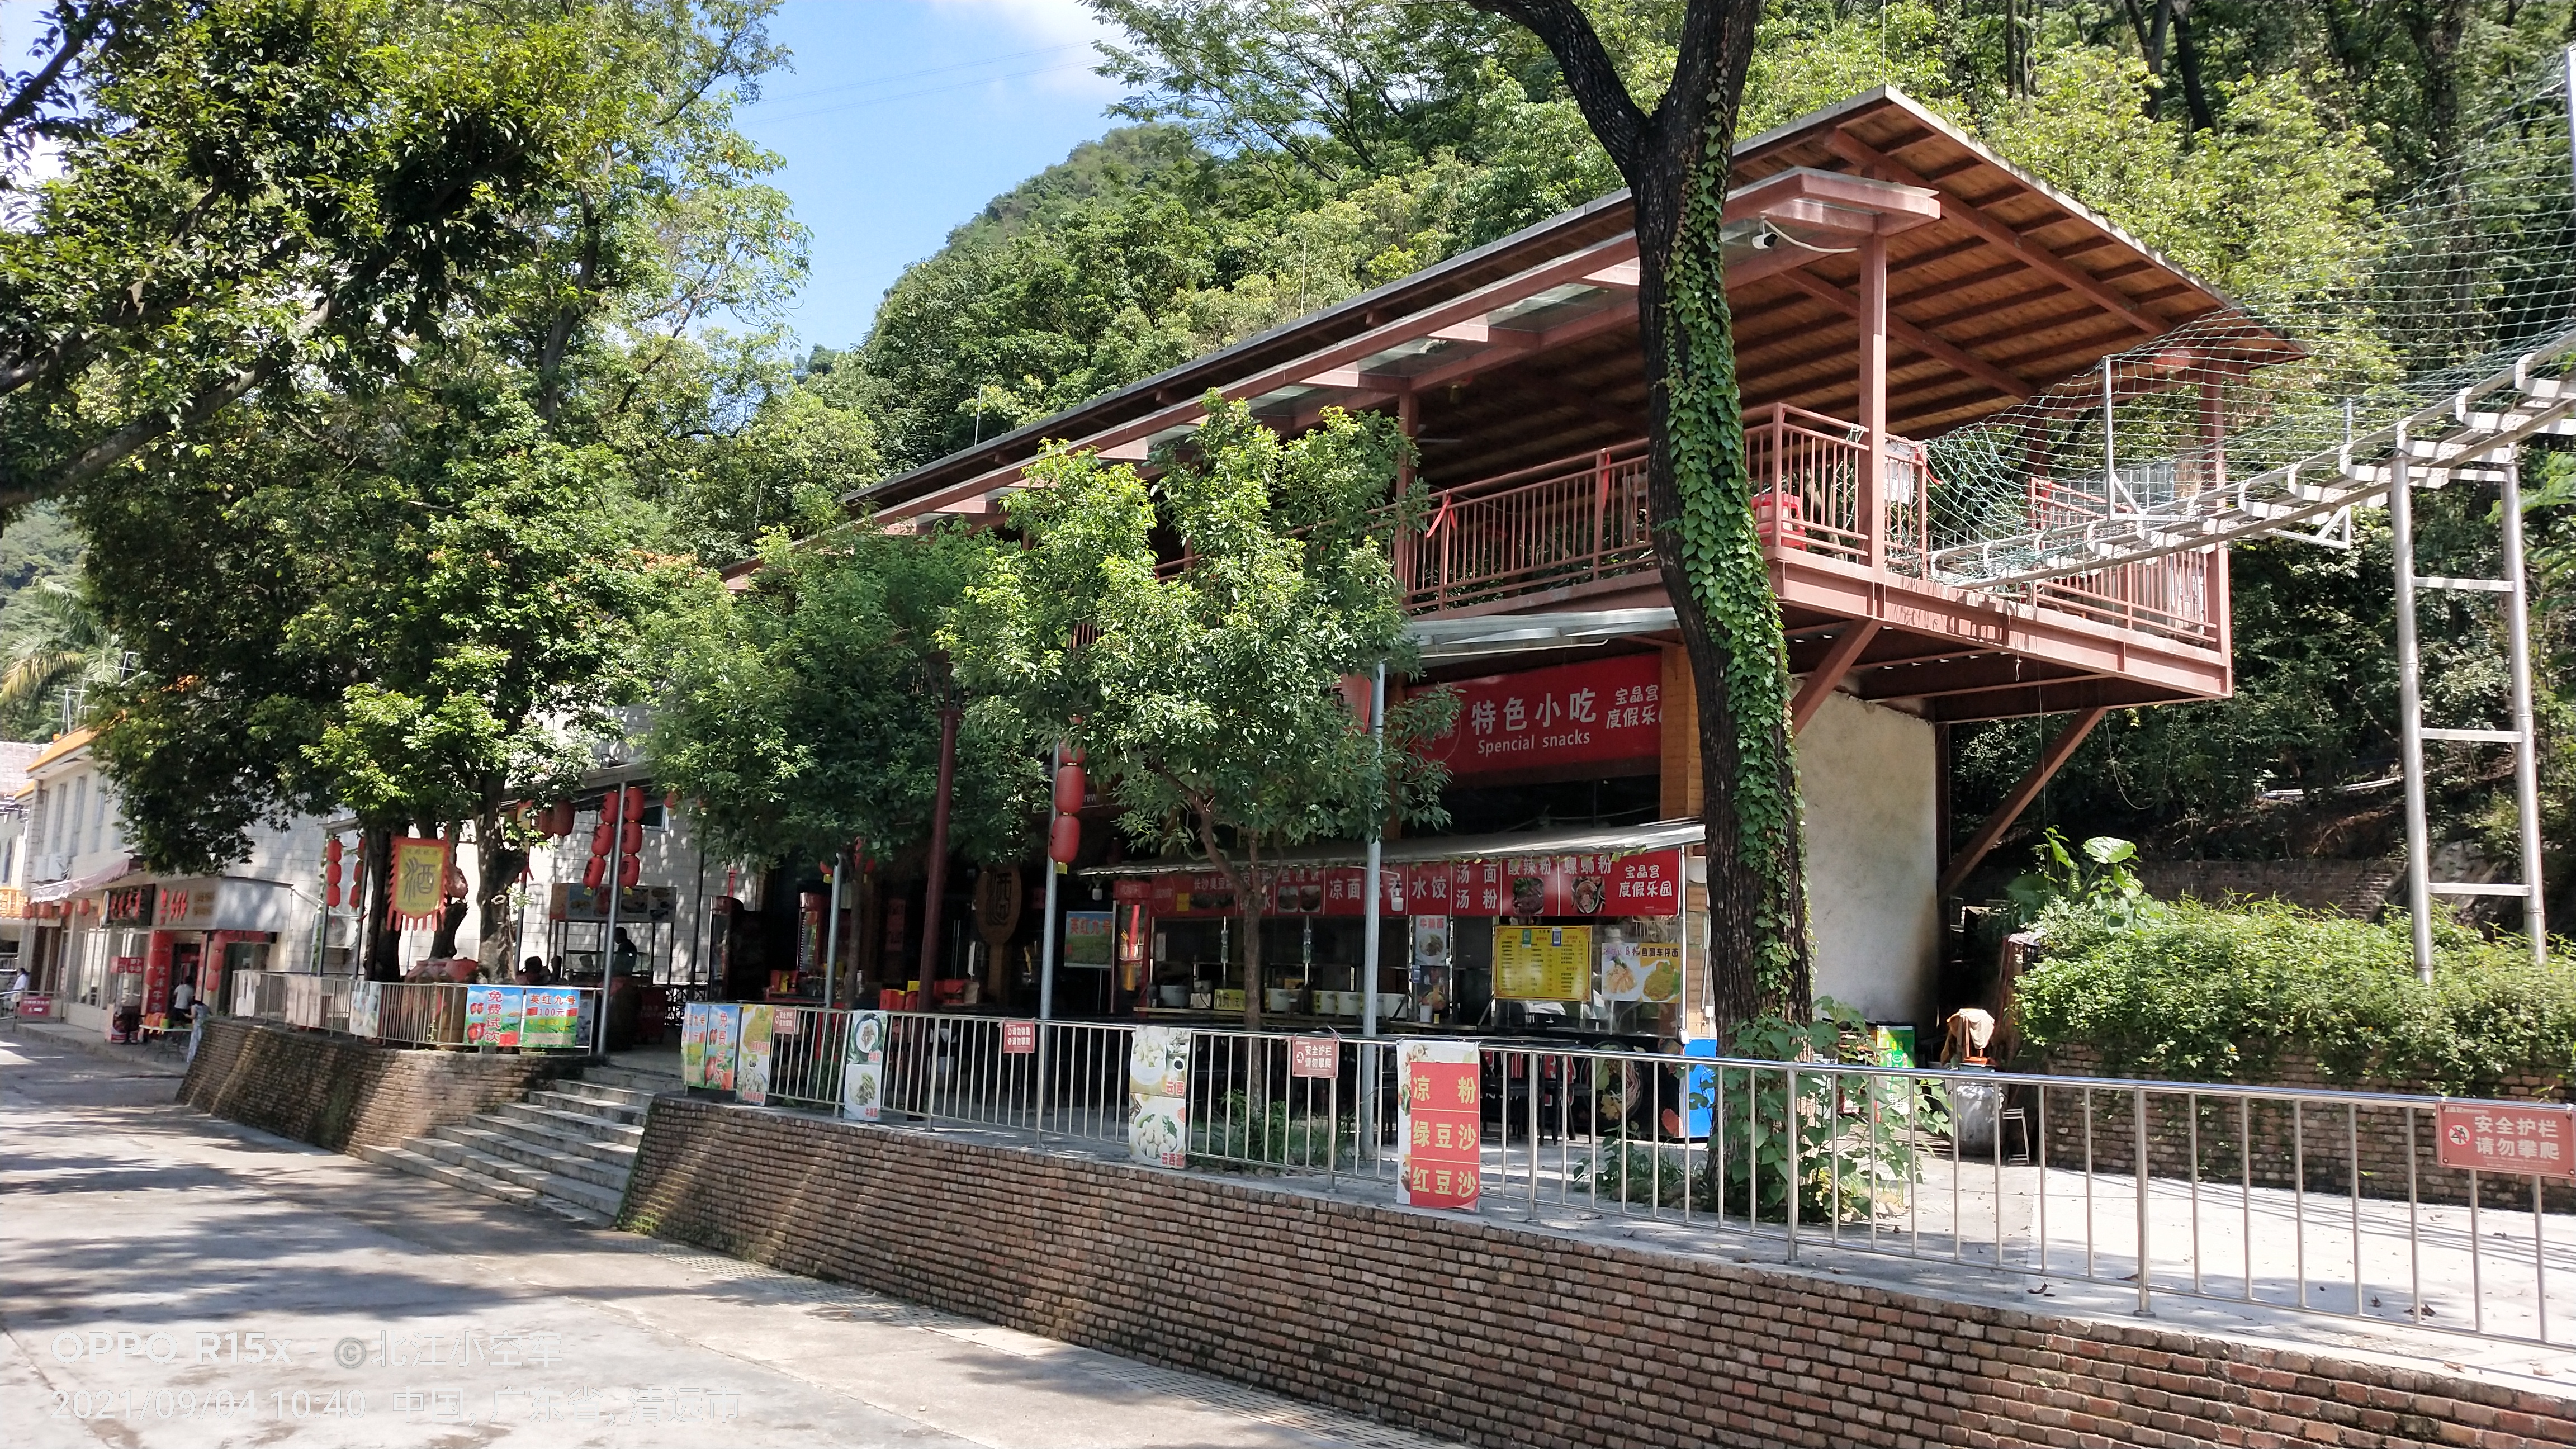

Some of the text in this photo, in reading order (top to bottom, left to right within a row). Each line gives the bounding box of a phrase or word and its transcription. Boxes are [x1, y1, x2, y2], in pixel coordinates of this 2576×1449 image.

[1614, 684, 1659, 706] 宝晶宫
[1471, 687, 1597, 736] 特色小吃
[1606, 704, 1662, 730] 度假乐
[1477, 728, 1590, 757] Spencial snacks
[1083, 792, 1097, 803] rew
[1456, 864, 1497, 884] 汤面
[1625, 864, 1660, 879] 宝晶宫
[1329, 878, 1361, 900] 凉面
[1412, 875, 1447, 899] 水饺
[1618, 880, 1673, 898] 度假乐园
[1456, 888, 1498, 910] 汤粉
[529, 995, 576, 1006] 英红九号
[483, 990, 503, 1043] 免费试饮
[538, 1008, 565, 1017] 100元
[1305, 1045, 1332, 1056] 安全护栏
[1305, 1057, 1332, 1069] 请勿攀爬
[1166, 1081, 1185, 1095] 云吞
[1413, 1074, 1477, 1104] 凉粉
[1413, 1120, 1477, 1151] 绿豆沙
[2474, 1115, 2559, 1138] 安全护栏
[2475, 1136, 2560, 1161] 请勿攀爬
[1412, 1166, 1477, 1198] 红豆沙
